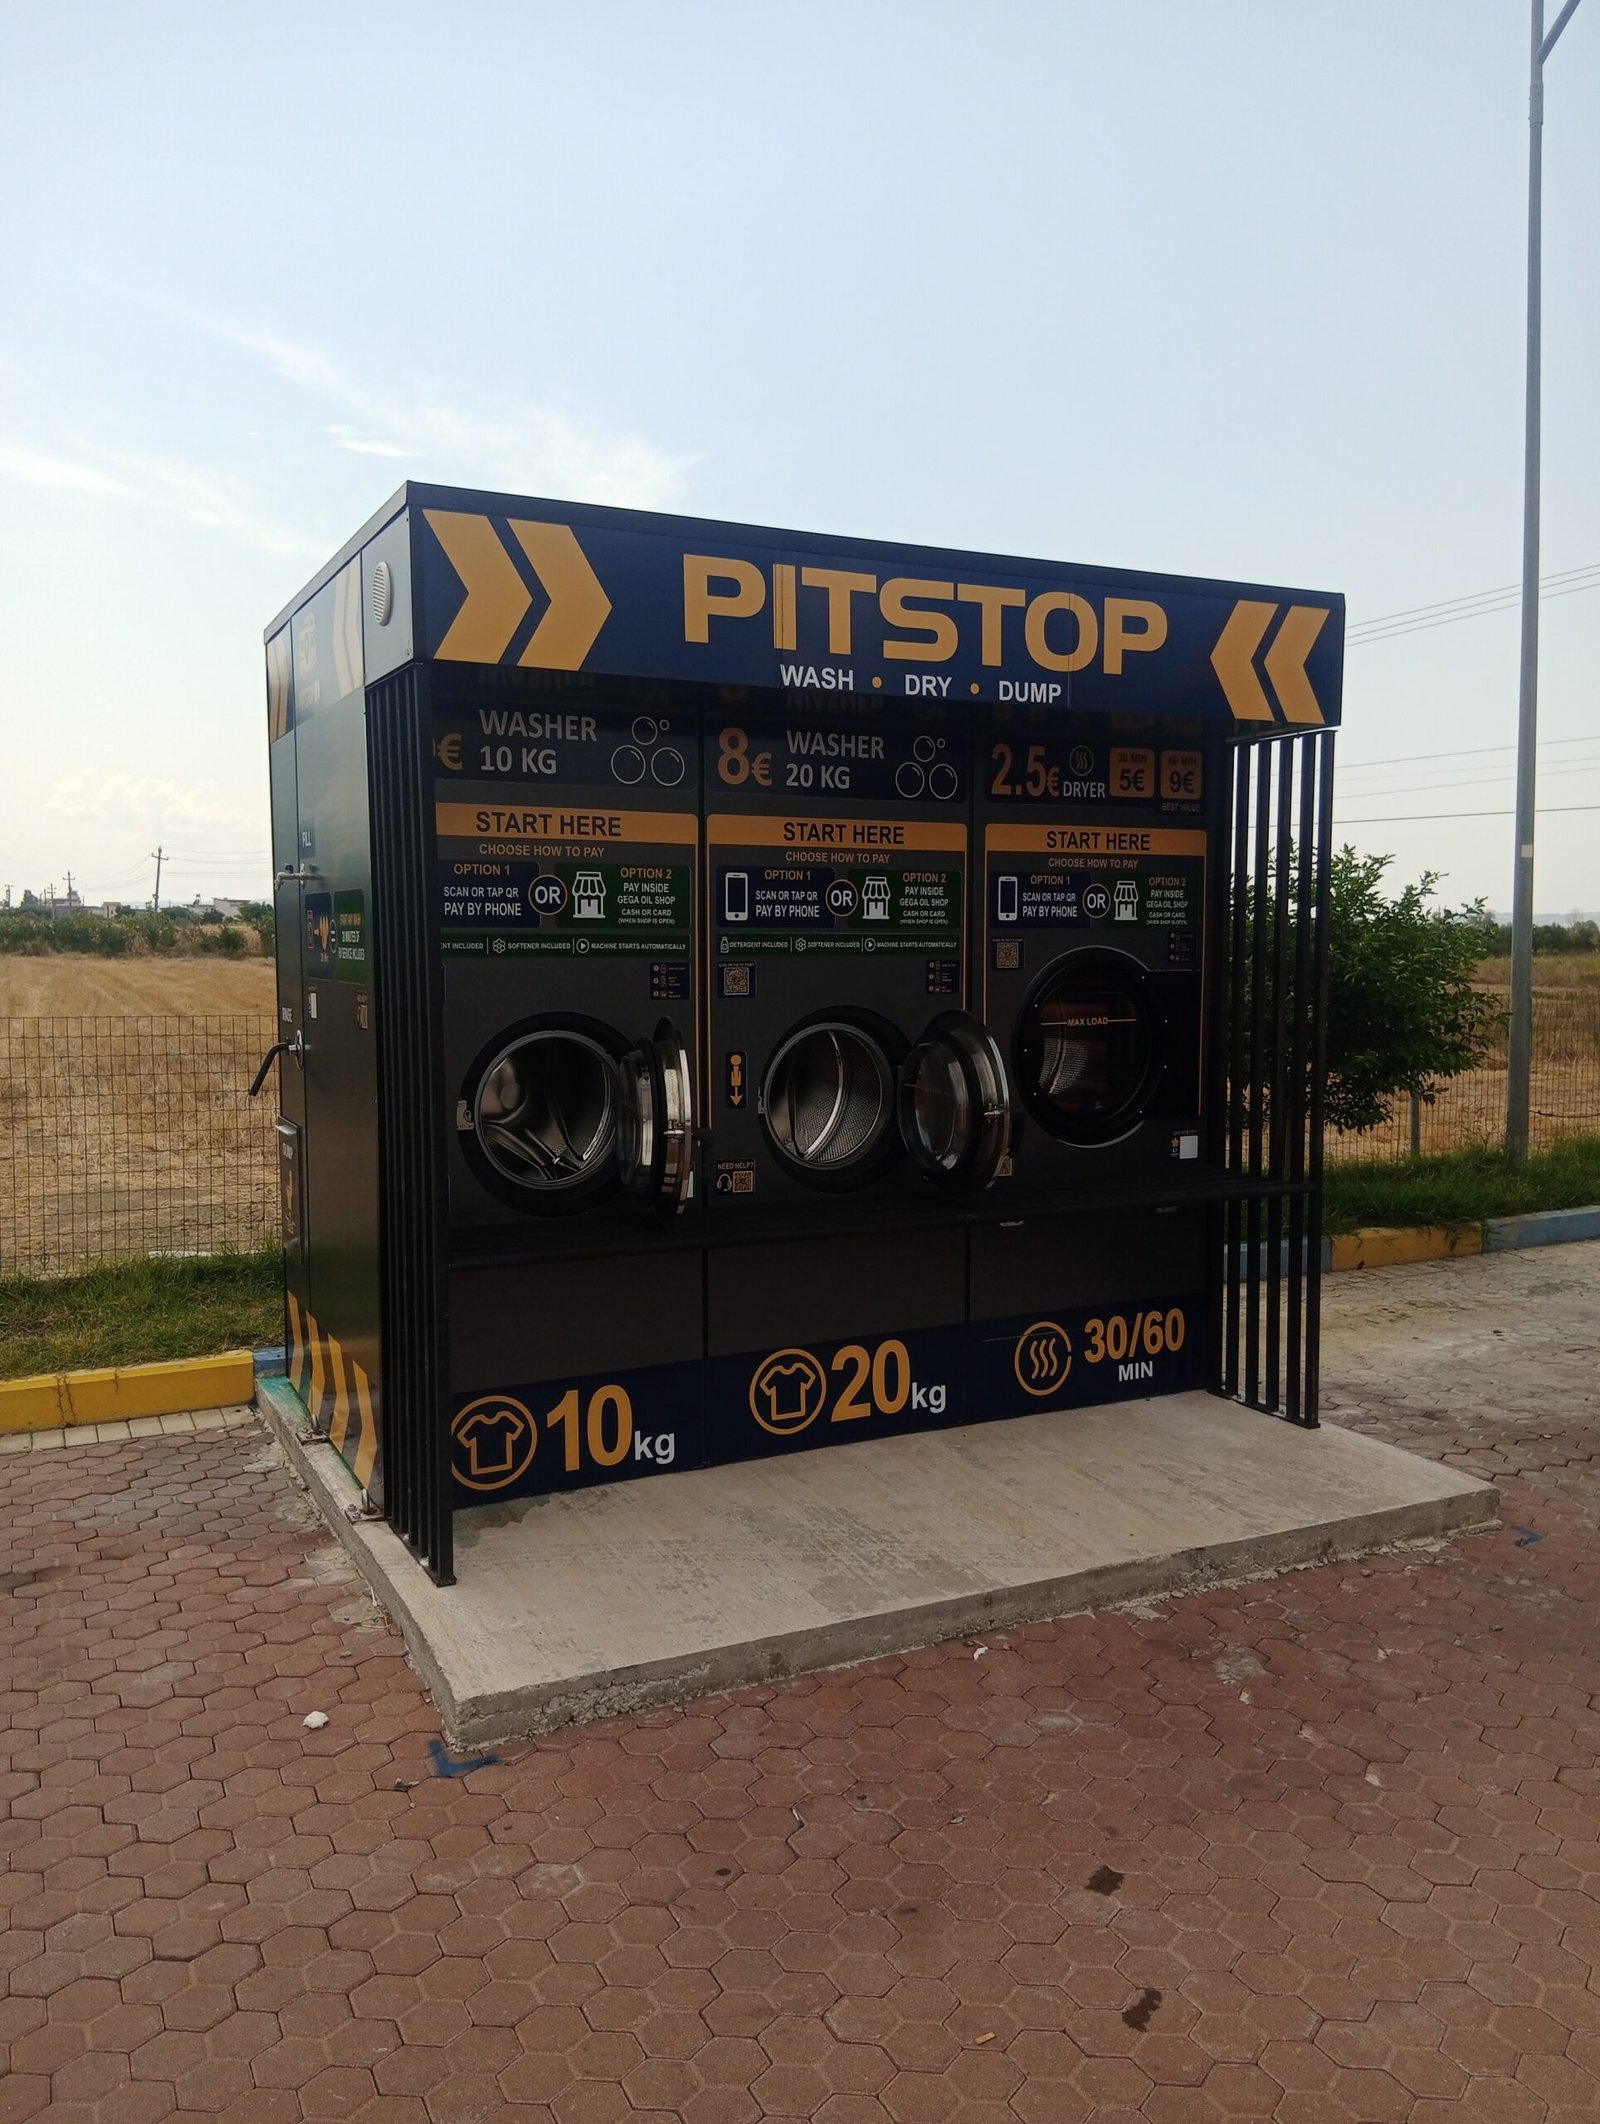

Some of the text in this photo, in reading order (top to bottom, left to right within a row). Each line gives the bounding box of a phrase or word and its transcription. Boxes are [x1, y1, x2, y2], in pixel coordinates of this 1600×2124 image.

[682, 553, 1168, 676] PITSTOP
[780, 664, 1062, 704] WASH DRY DUMP
[478, 709, 597, 742] WASHER
[786, 729, 885, 760] WASHER
[480, 745, 557, 775] 10 KG
[717, 727, 773, 786] 8€
[991, 742, 1061, 797] 2.5€
[786, 763, 851, 790] 20 KG
[1119, 768, 1145, 792] 5€
[1170, 771, 1195, 794] 9€
[1062, 780, 1106, 798] DRYER
[1161, 802, 1179, 811] BEST
[476, 811, 622, 837] START HERE
[783, 822, 904, 844] START HERE
[1047, 831, 1150, 851] START HERE
[479, 843, 605, 859] CHOOSE HOW TO PAY
[785, 851, 890, 864] CHOOSE HOW TO PAY
[454, 863, 511, 876] OPTION 1
[1048, 858, 1138, 869] CHOOSE HOW TO PAY
[620, 867, 672, 879] OPTION 2
[764, 869, 811, 881] OPTION 1
[902, 872, 946, 883] OPTION 2
[1030, 875, 1070, 886] OPTION 1
[1148, 876, 1186, 886] OPTION 2
[444, 887, 519, 899] SCAN OR TAP QR
[623, 882, 669, 893] PAY INSIDE
[905, 886, 944, 896] PAY INSIDE
[1150, 889, 1184, 899] PAY INSIDE
[534, 885, 562, 904] OR
[617, 895, 675, 905] GEGA OIL SHOP
[755, 890, 818, 902] SCAN OR TAP QR
[830, 890, 853, 907] OR
[1022, 892, 1076, 903] SCAN OR TAP QR
[1087, 893, 1106, 909] OR
[444, 902, 522, 916] PAY BY PHONE
[900, 898, 918, 906] GEGA
[931, 898, 949, 907] SHOP
[621, 908, 672, 916] CASH OR CARD
[755, 904, 820, 918] PAY BY PHONE
[903, 910, 945, 918] CASH OR CARD
[1022, 905, 1078, 918] PAY BY PHONE
[452, 942, 484, 950] INCLUDED
[507, 942, 571, 950] SOFTENER INCLUDED
[591, 942, 617, 950] MACHINE
[1067, 1016, 1109, 1027] MAX LOAD
[718, 1161, 754, 1170] NEED HELP?
[1082, 1306, 1187, 1366] 30/60
[1117, 1359, 1155, 1383] MIN
